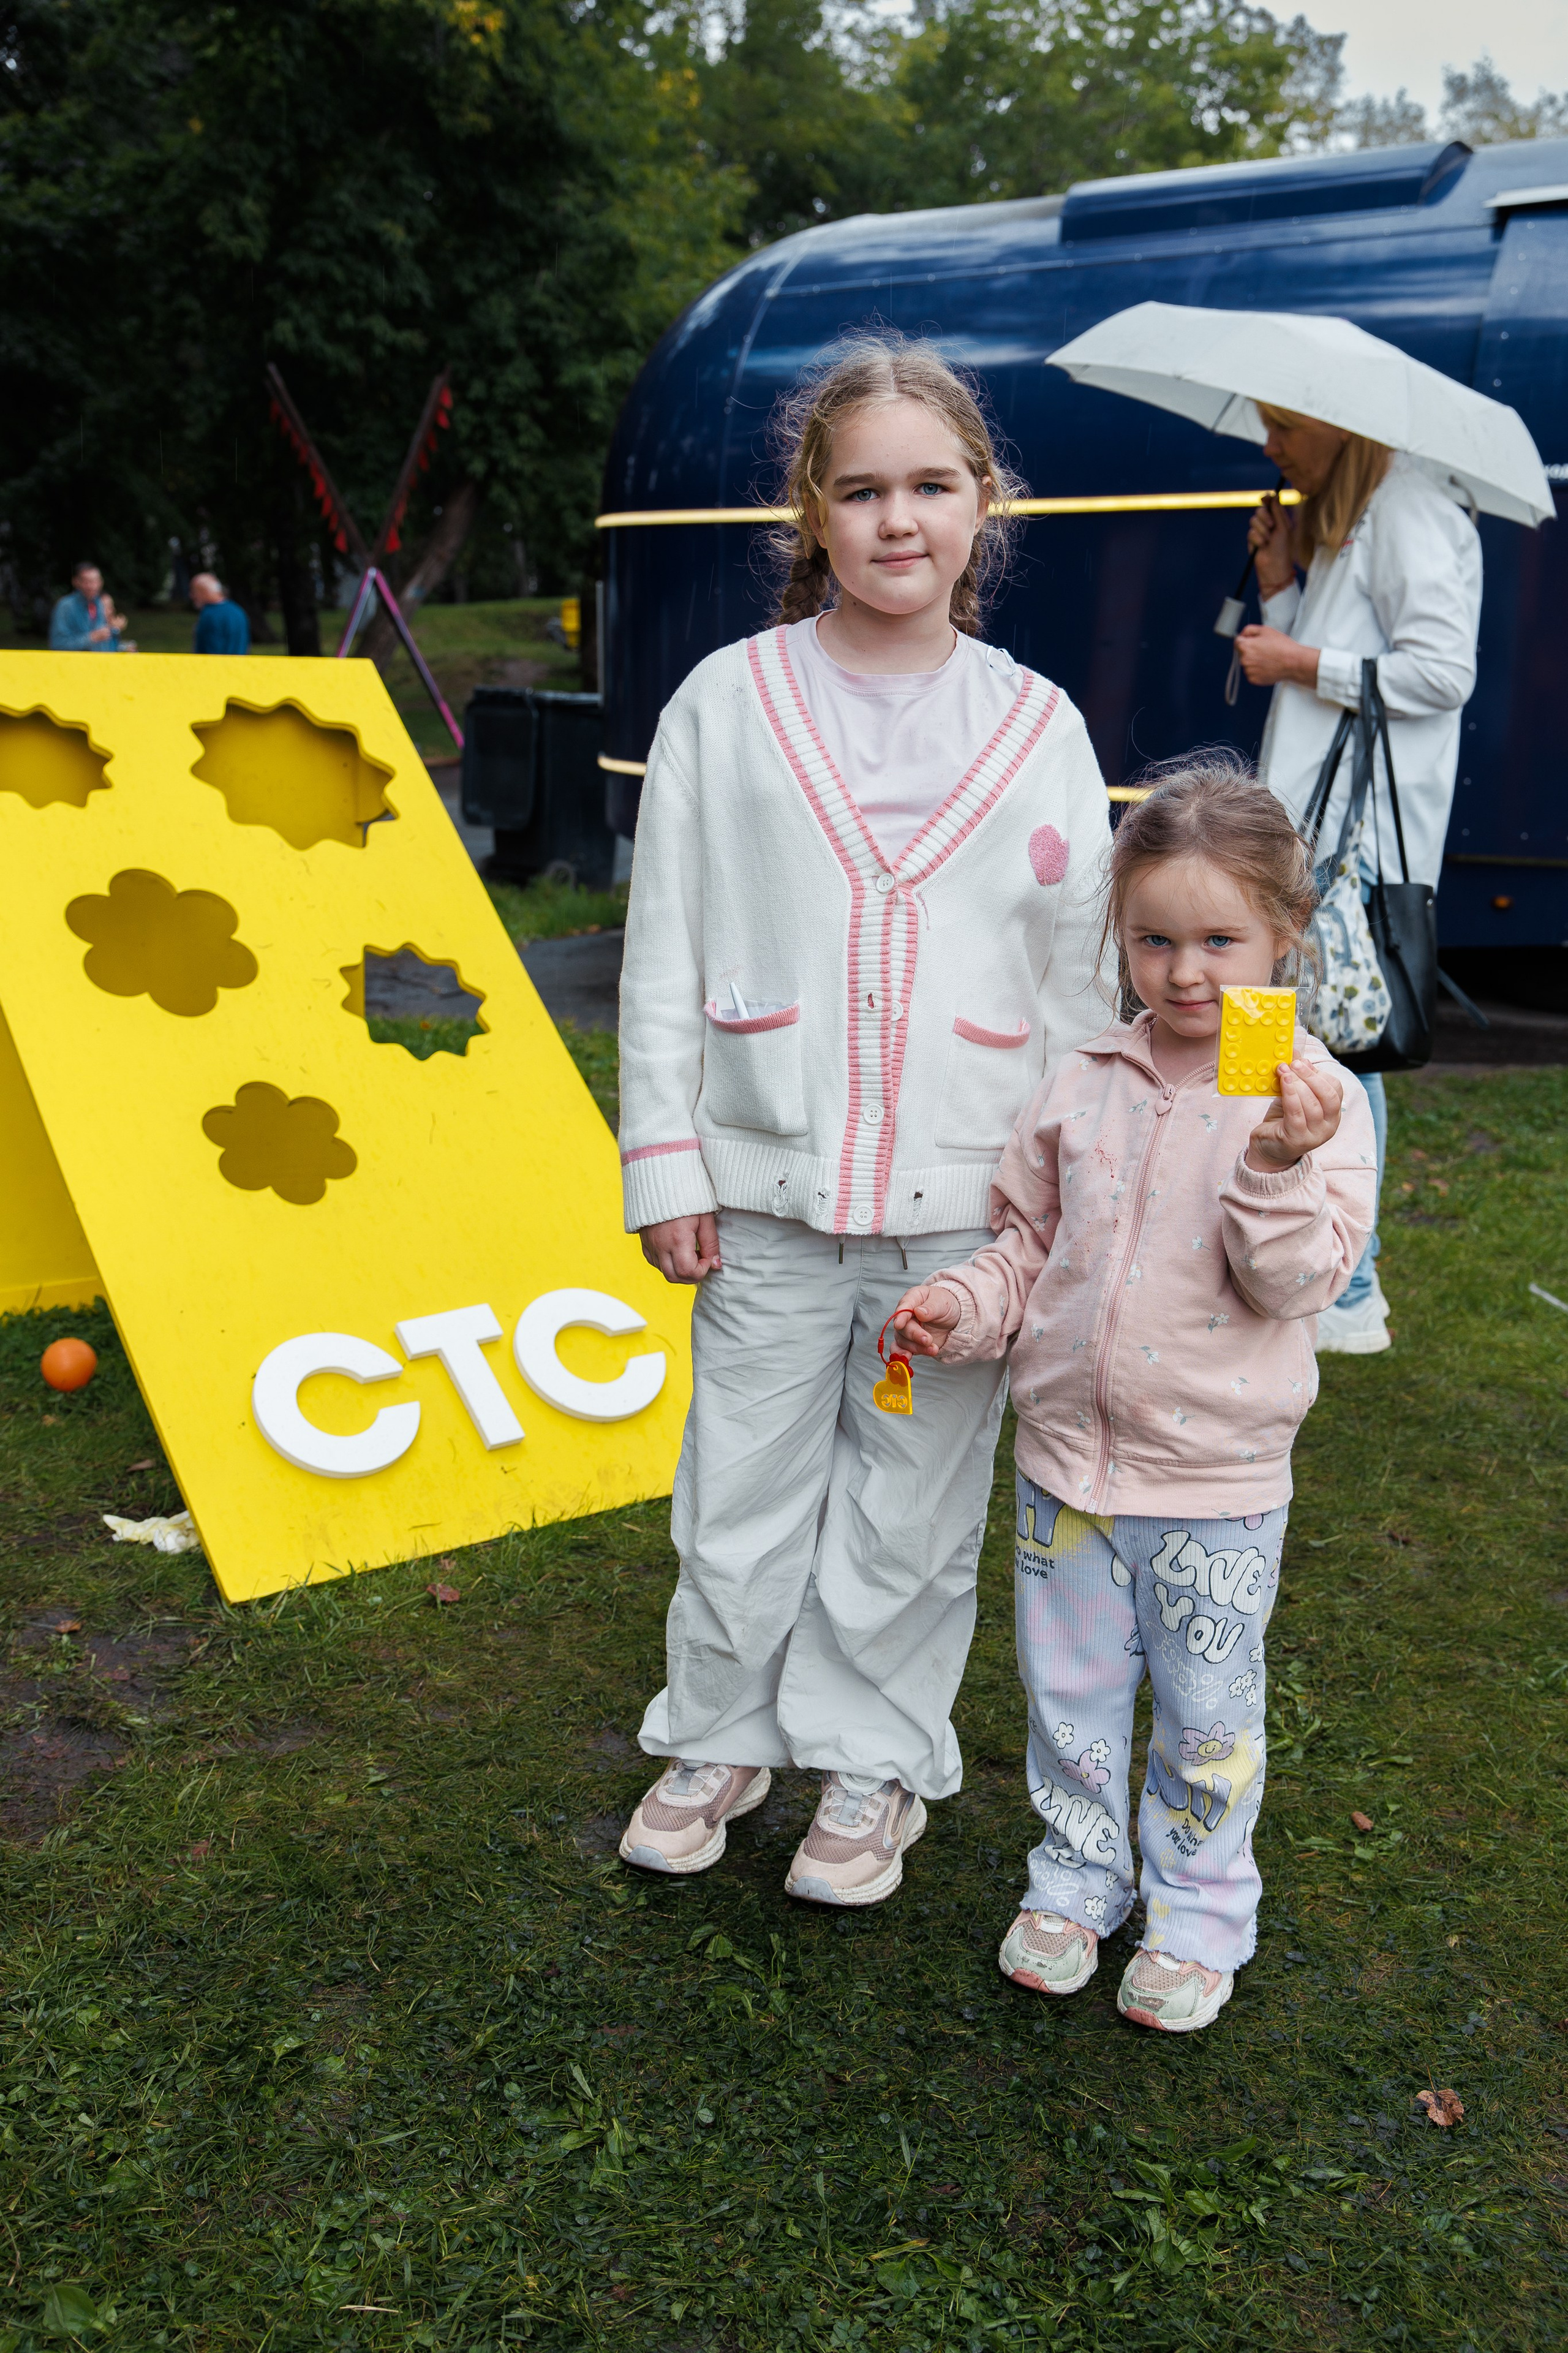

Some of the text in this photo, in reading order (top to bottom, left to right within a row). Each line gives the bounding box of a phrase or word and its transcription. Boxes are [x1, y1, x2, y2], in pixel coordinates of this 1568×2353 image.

[1021, 1560, 1048, 1579] love
[1023, 1550, 1055, 1569] what
[1150, 1530, 1265, 1615] LOVE
[1153, 1582, 1245, 1664] YOU
